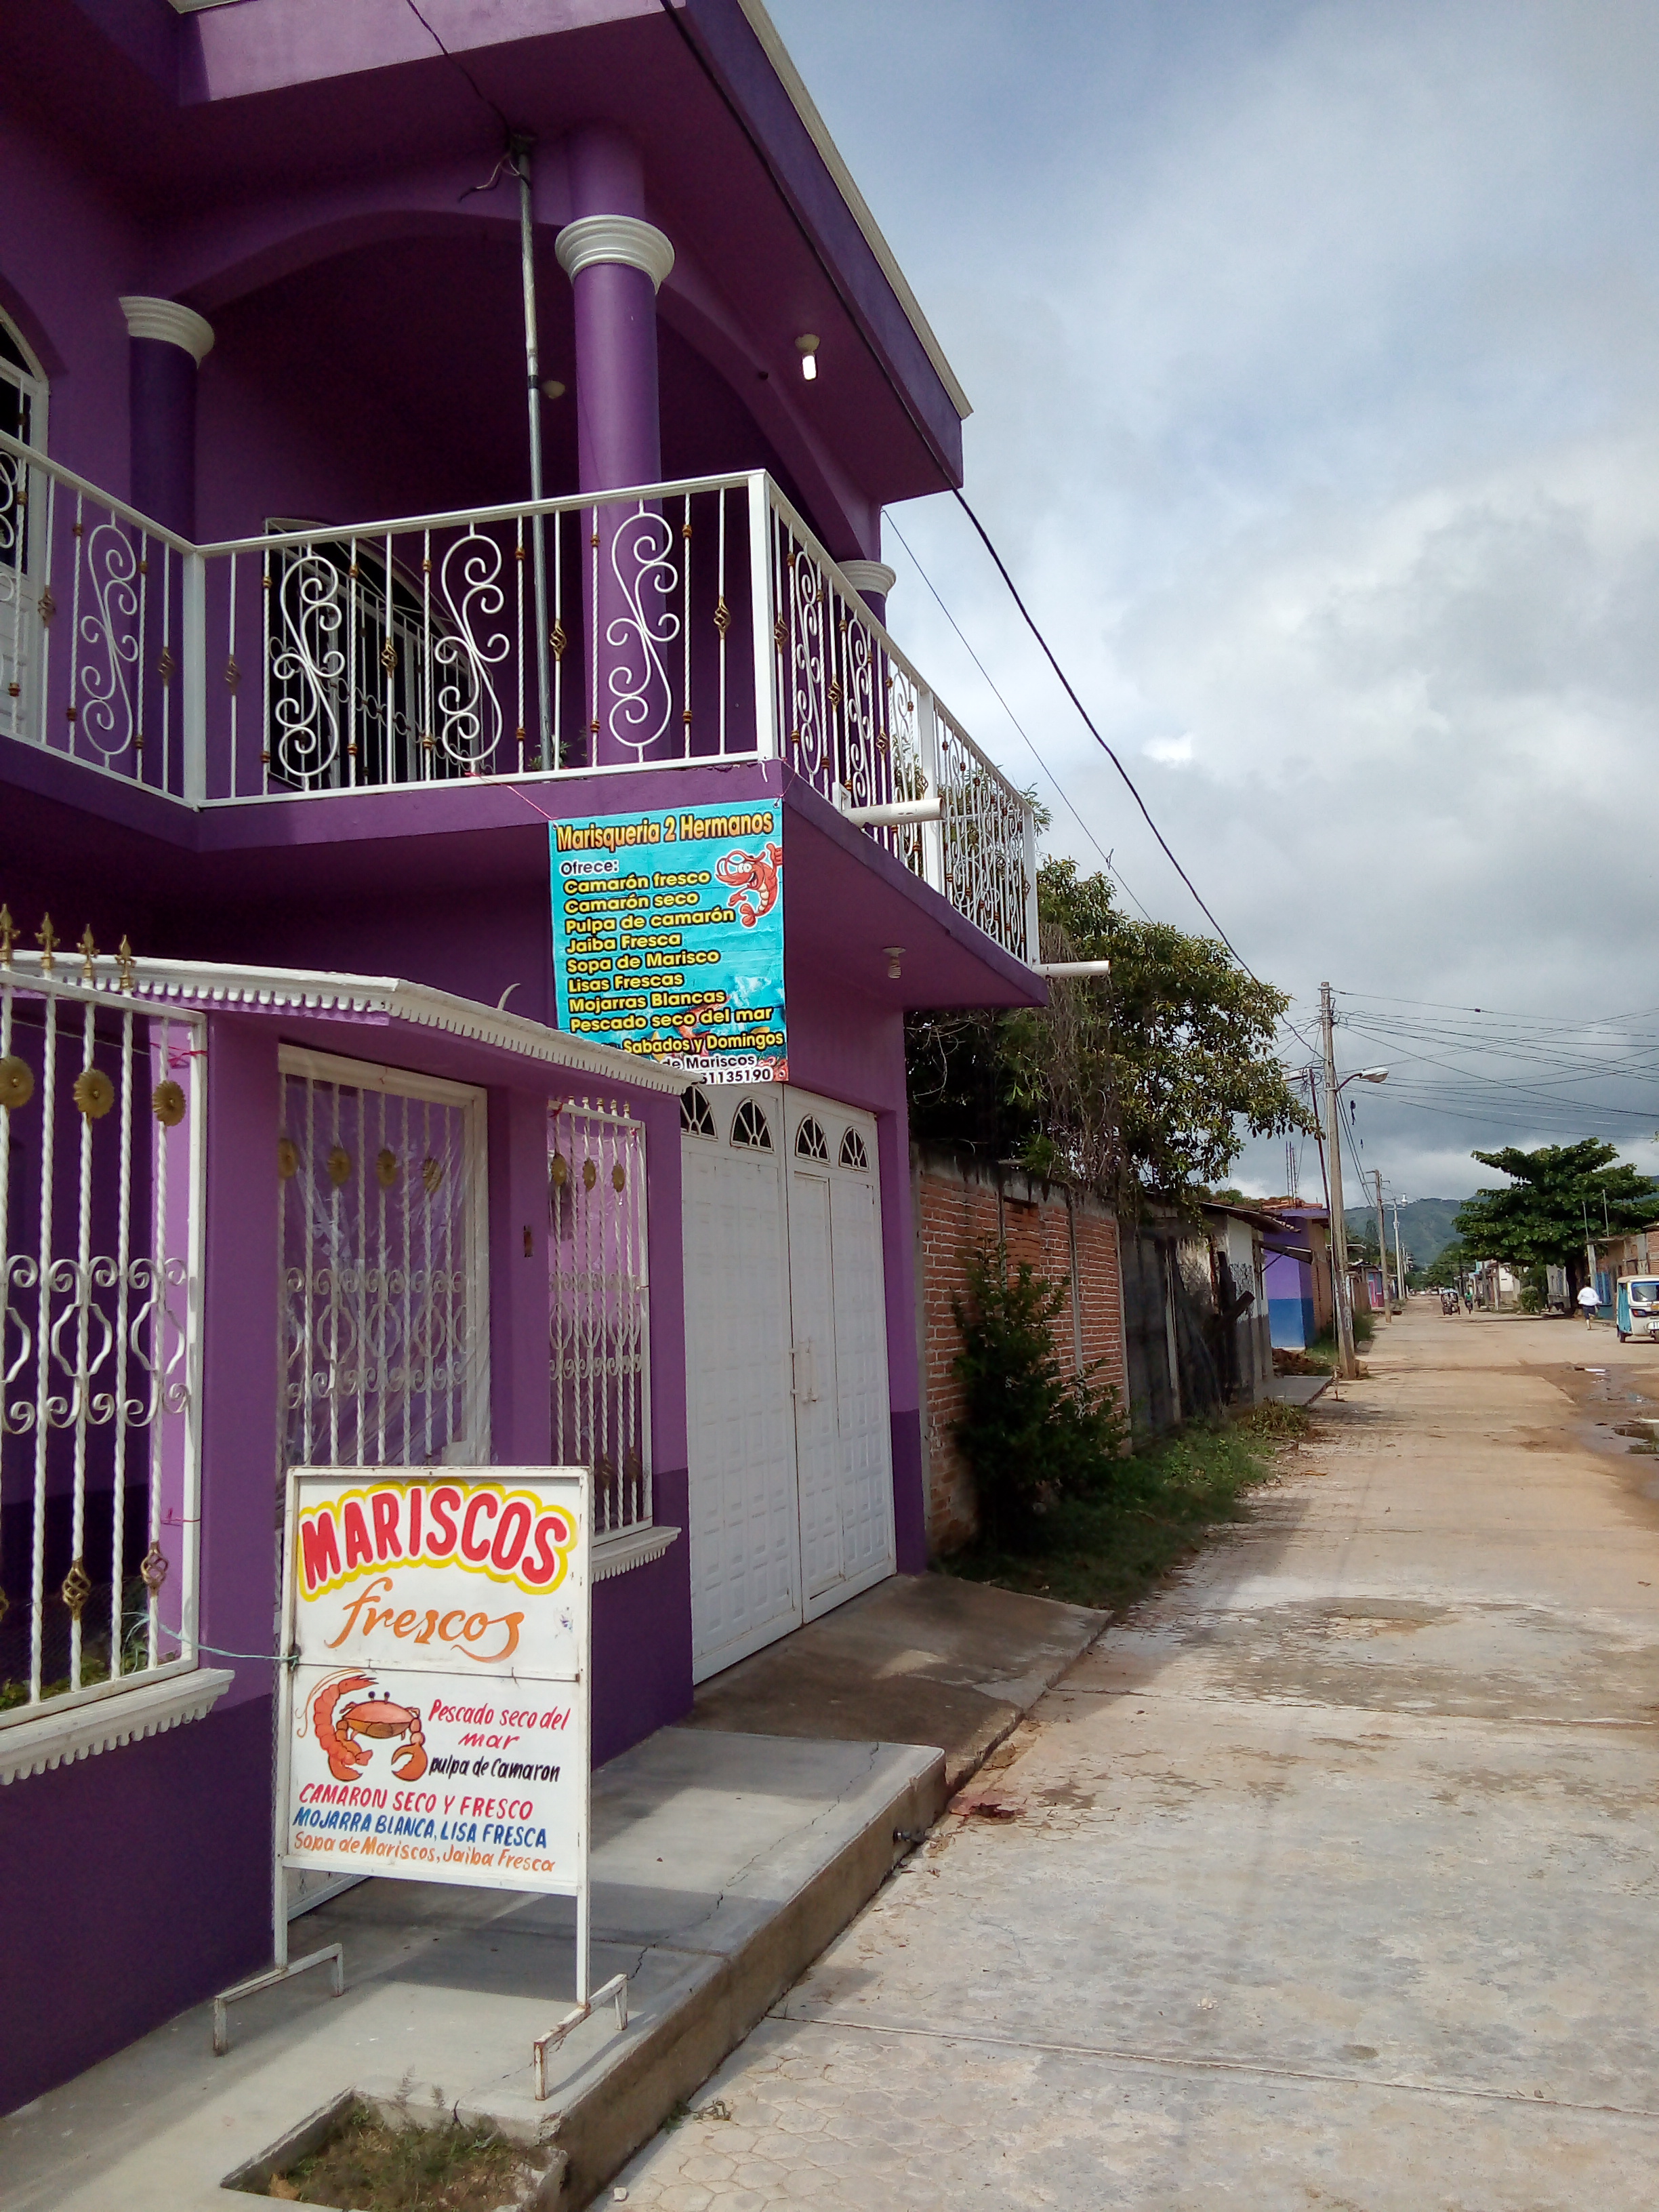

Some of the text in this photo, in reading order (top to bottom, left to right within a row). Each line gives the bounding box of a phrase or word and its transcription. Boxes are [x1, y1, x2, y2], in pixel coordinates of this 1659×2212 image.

[556, 813, 774, 853] Marisqueria 2 Hermanos
[560, 859, 619, 877] Ofrece:
[563, 871, 711, 895] Camarón fresco
[564, 891, 699, 914] Camarón seco
[565, 906, 735, 935] Pulpa de camarón
[566, 933, 681, 954] Jaiba Fresca
[567, 950, 720, 975] Sopa de Marisco
[568, 972, 684, 994] Lisas Frescas
[569, 990, 725, 1014] Mojarras Blancas
[570, 1006, 773, 1033] Pescado seco del mar
[623, 1038, 691, 1053] Sabados
[694, 1036, 703, 1052] y
[706, 1032, 784, 1050] Domingos
[686, 1052, 755, 1069] Mariscos
[301, 1486, 568, 1591] MARISCOS
[323, 1576, 525, 1664] frescos
[428, 1698, 571, 1731] Pescado seco del
[457, 1732, 520, 1750] mar
[428, 1754, 561, 1783] pulpa de Camaron
[298, 1782, 534, 1821] CAMARON SECO Y FRESCO
[292, 1805, 548, 1849] MOJARRA BLANCA, LISA FRESCA
[294, 1831, 556, 1872] Sopa de Mariscos, Jaiba Fresca
